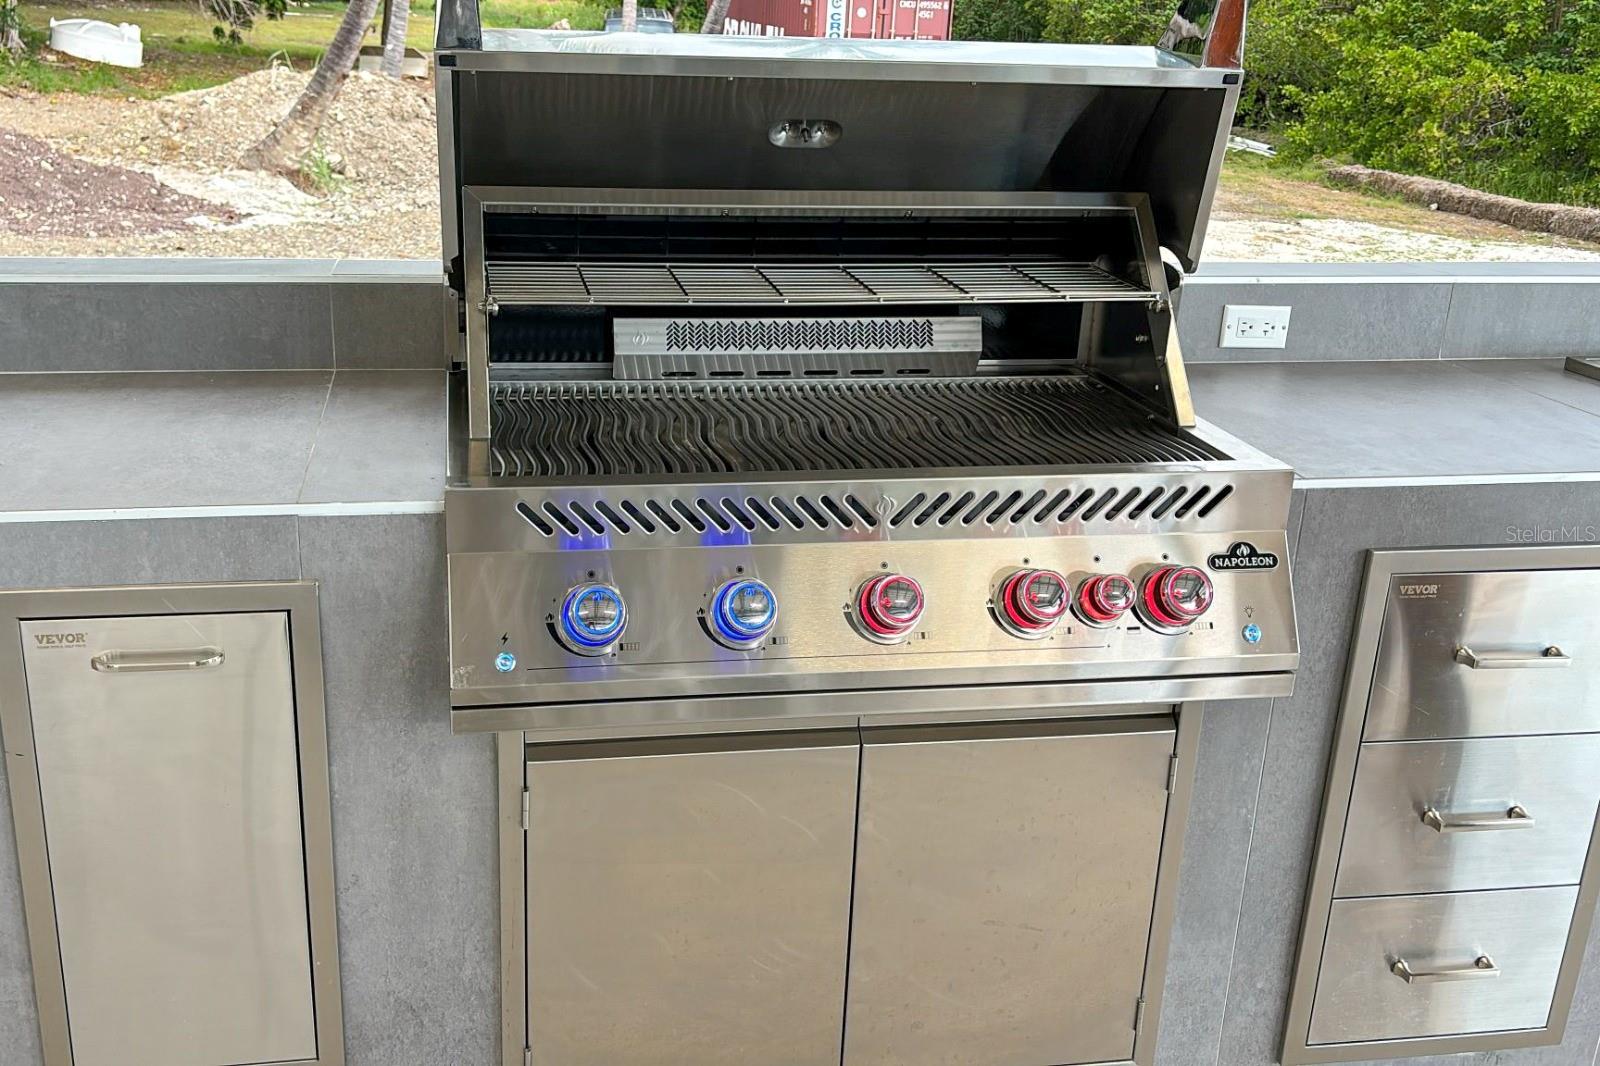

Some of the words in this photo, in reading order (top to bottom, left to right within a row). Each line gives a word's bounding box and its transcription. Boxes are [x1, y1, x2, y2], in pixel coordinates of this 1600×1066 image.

[1214, 556, 1274, 567] NAPOLEON
[1400, 584, 1438, 595] VEVOR
[34, 632, 86, 645] VEVOR
